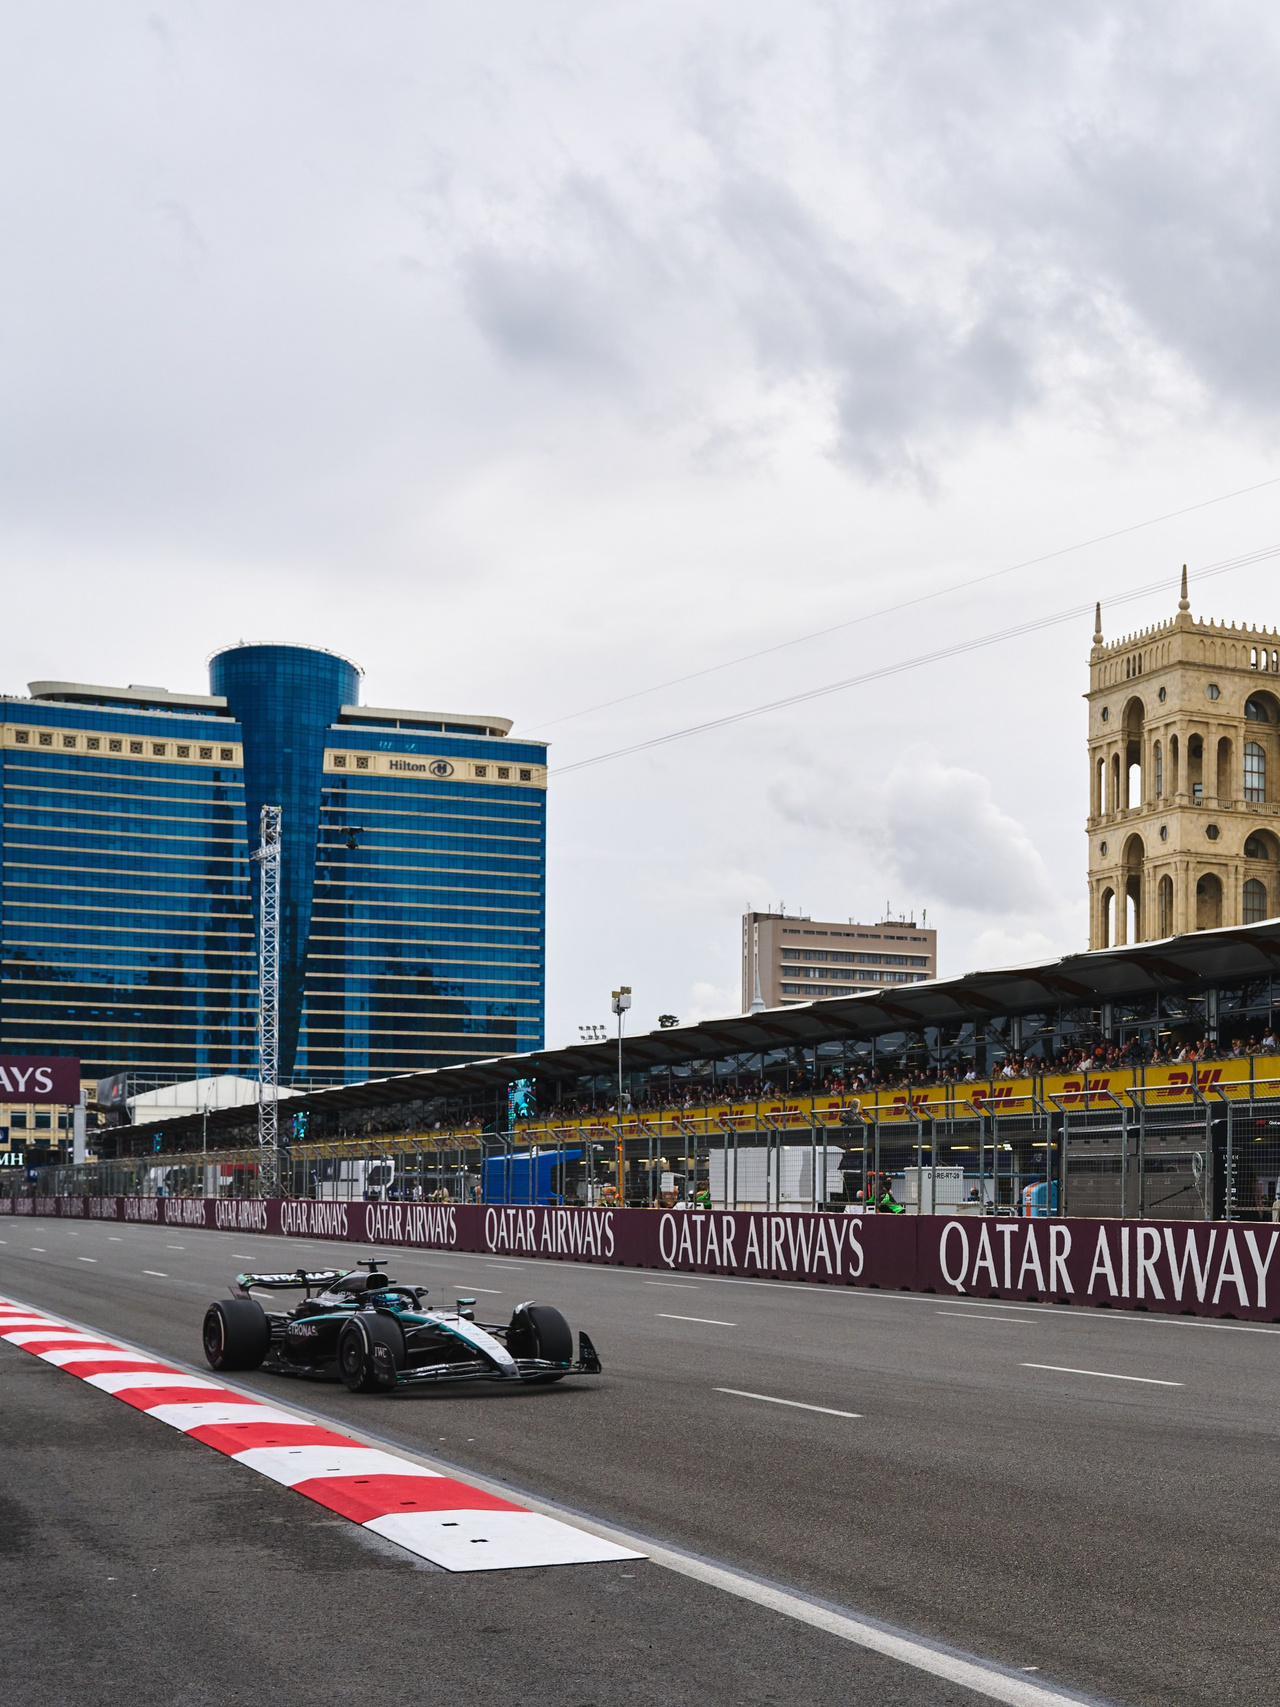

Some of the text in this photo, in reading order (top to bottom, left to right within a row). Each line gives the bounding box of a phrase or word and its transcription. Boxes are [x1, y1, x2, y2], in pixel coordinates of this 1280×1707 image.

[389, 760, 426, 772] Hilton
[0, 1066, 53, 1093] AYS
[1062, 1079, 1111, 1103] DHL
[1167, 1069, 1224, 1096] DHL
[893, 1094, 929, 1115] DHL
[971, 1087, 1014, 1110] DHL
[717, 1110, 745, 1127] DHL
[770, 1105, 800, 1124] DHL
[0, 1152, 24, 1166] MH
[928, 1173, 960, 1181] D-RE-RT-20
[215, 1200, 268, 1230] QATAR AIRWAYS
[280, 1202, 348, 1236] QATAR AIRWAYS
[365, 1204, 457, 1245] QATAR AIRWAYS
[485, 1208, 615, 1257] QATAR AIRWAYS
[659, 1213, 864, 1276] QATAR AIRWAYS
[940, 1221, 1075, 1293] QATAR
[250, 1271, 336, 1283] PETRONAS
[288, 1324, 318, 1337] ETRONAS
[375, 1346, 388, 1358] IWC
